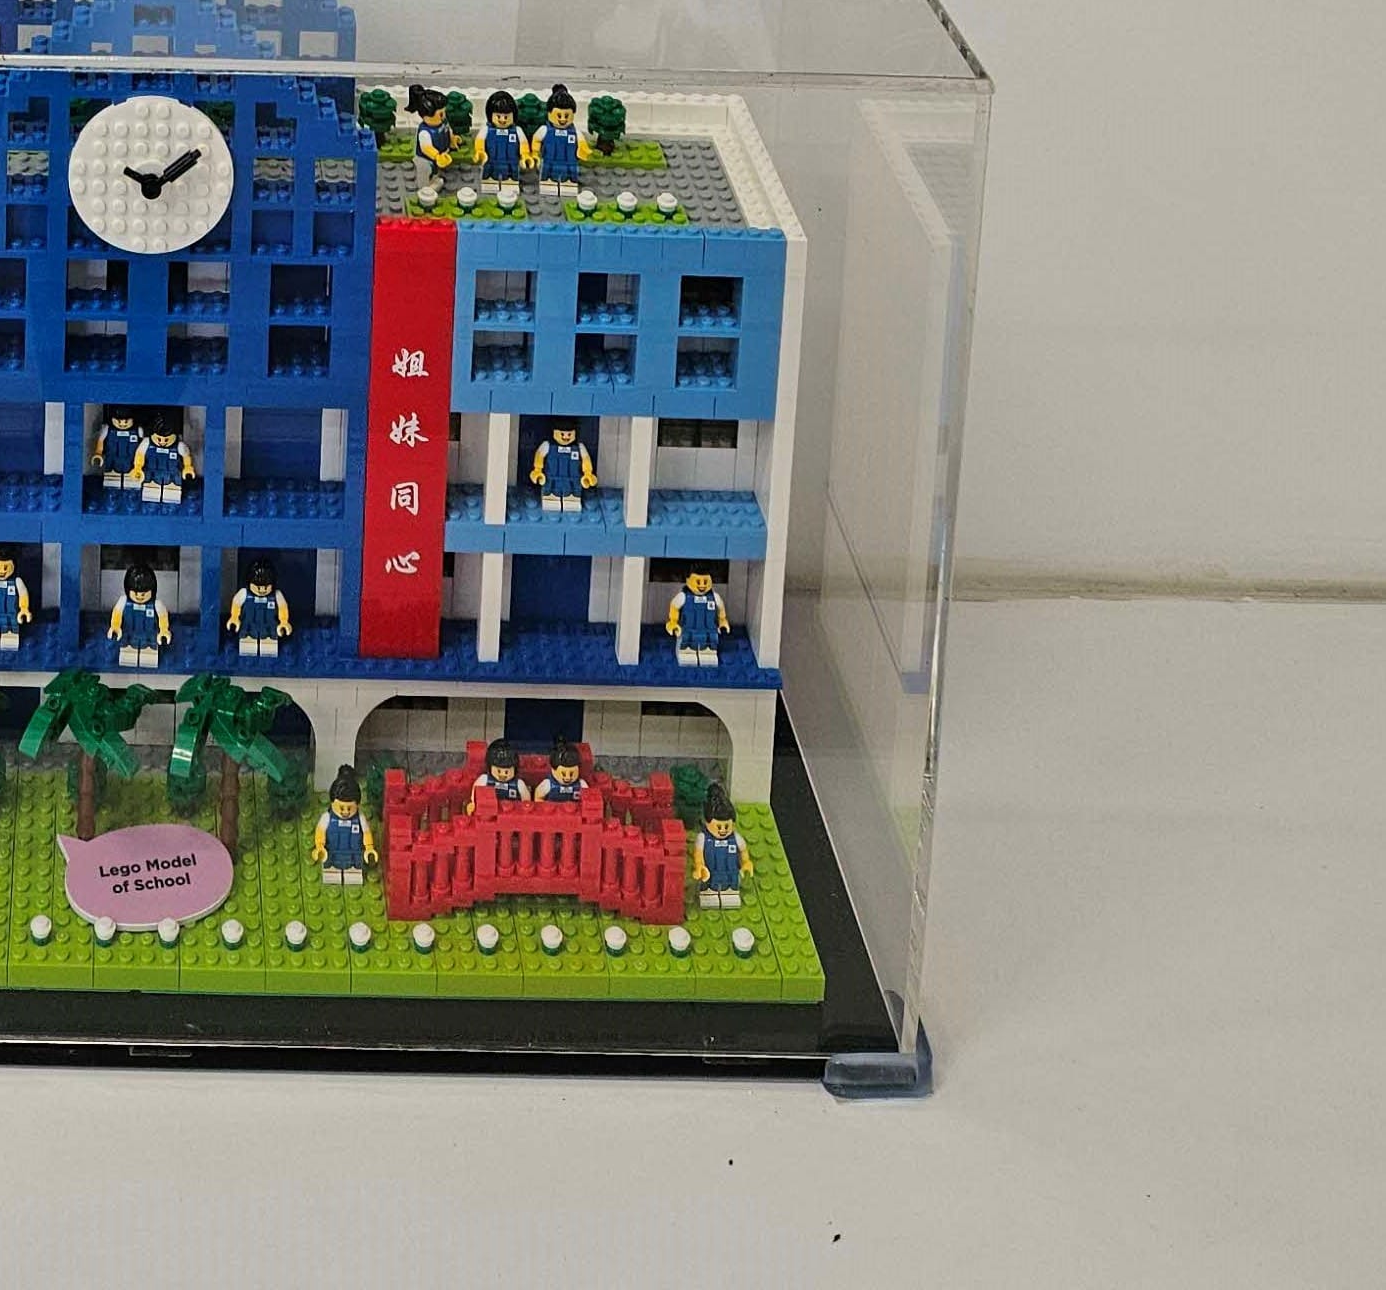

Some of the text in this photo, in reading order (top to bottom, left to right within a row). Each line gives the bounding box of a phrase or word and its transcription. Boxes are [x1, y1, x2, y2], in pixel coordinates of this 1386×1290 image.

[385, 348, 430, 575] 姐妹同心
[99, 853, 197, 878] Lego Model
[112, 873, 192, 894] of School
